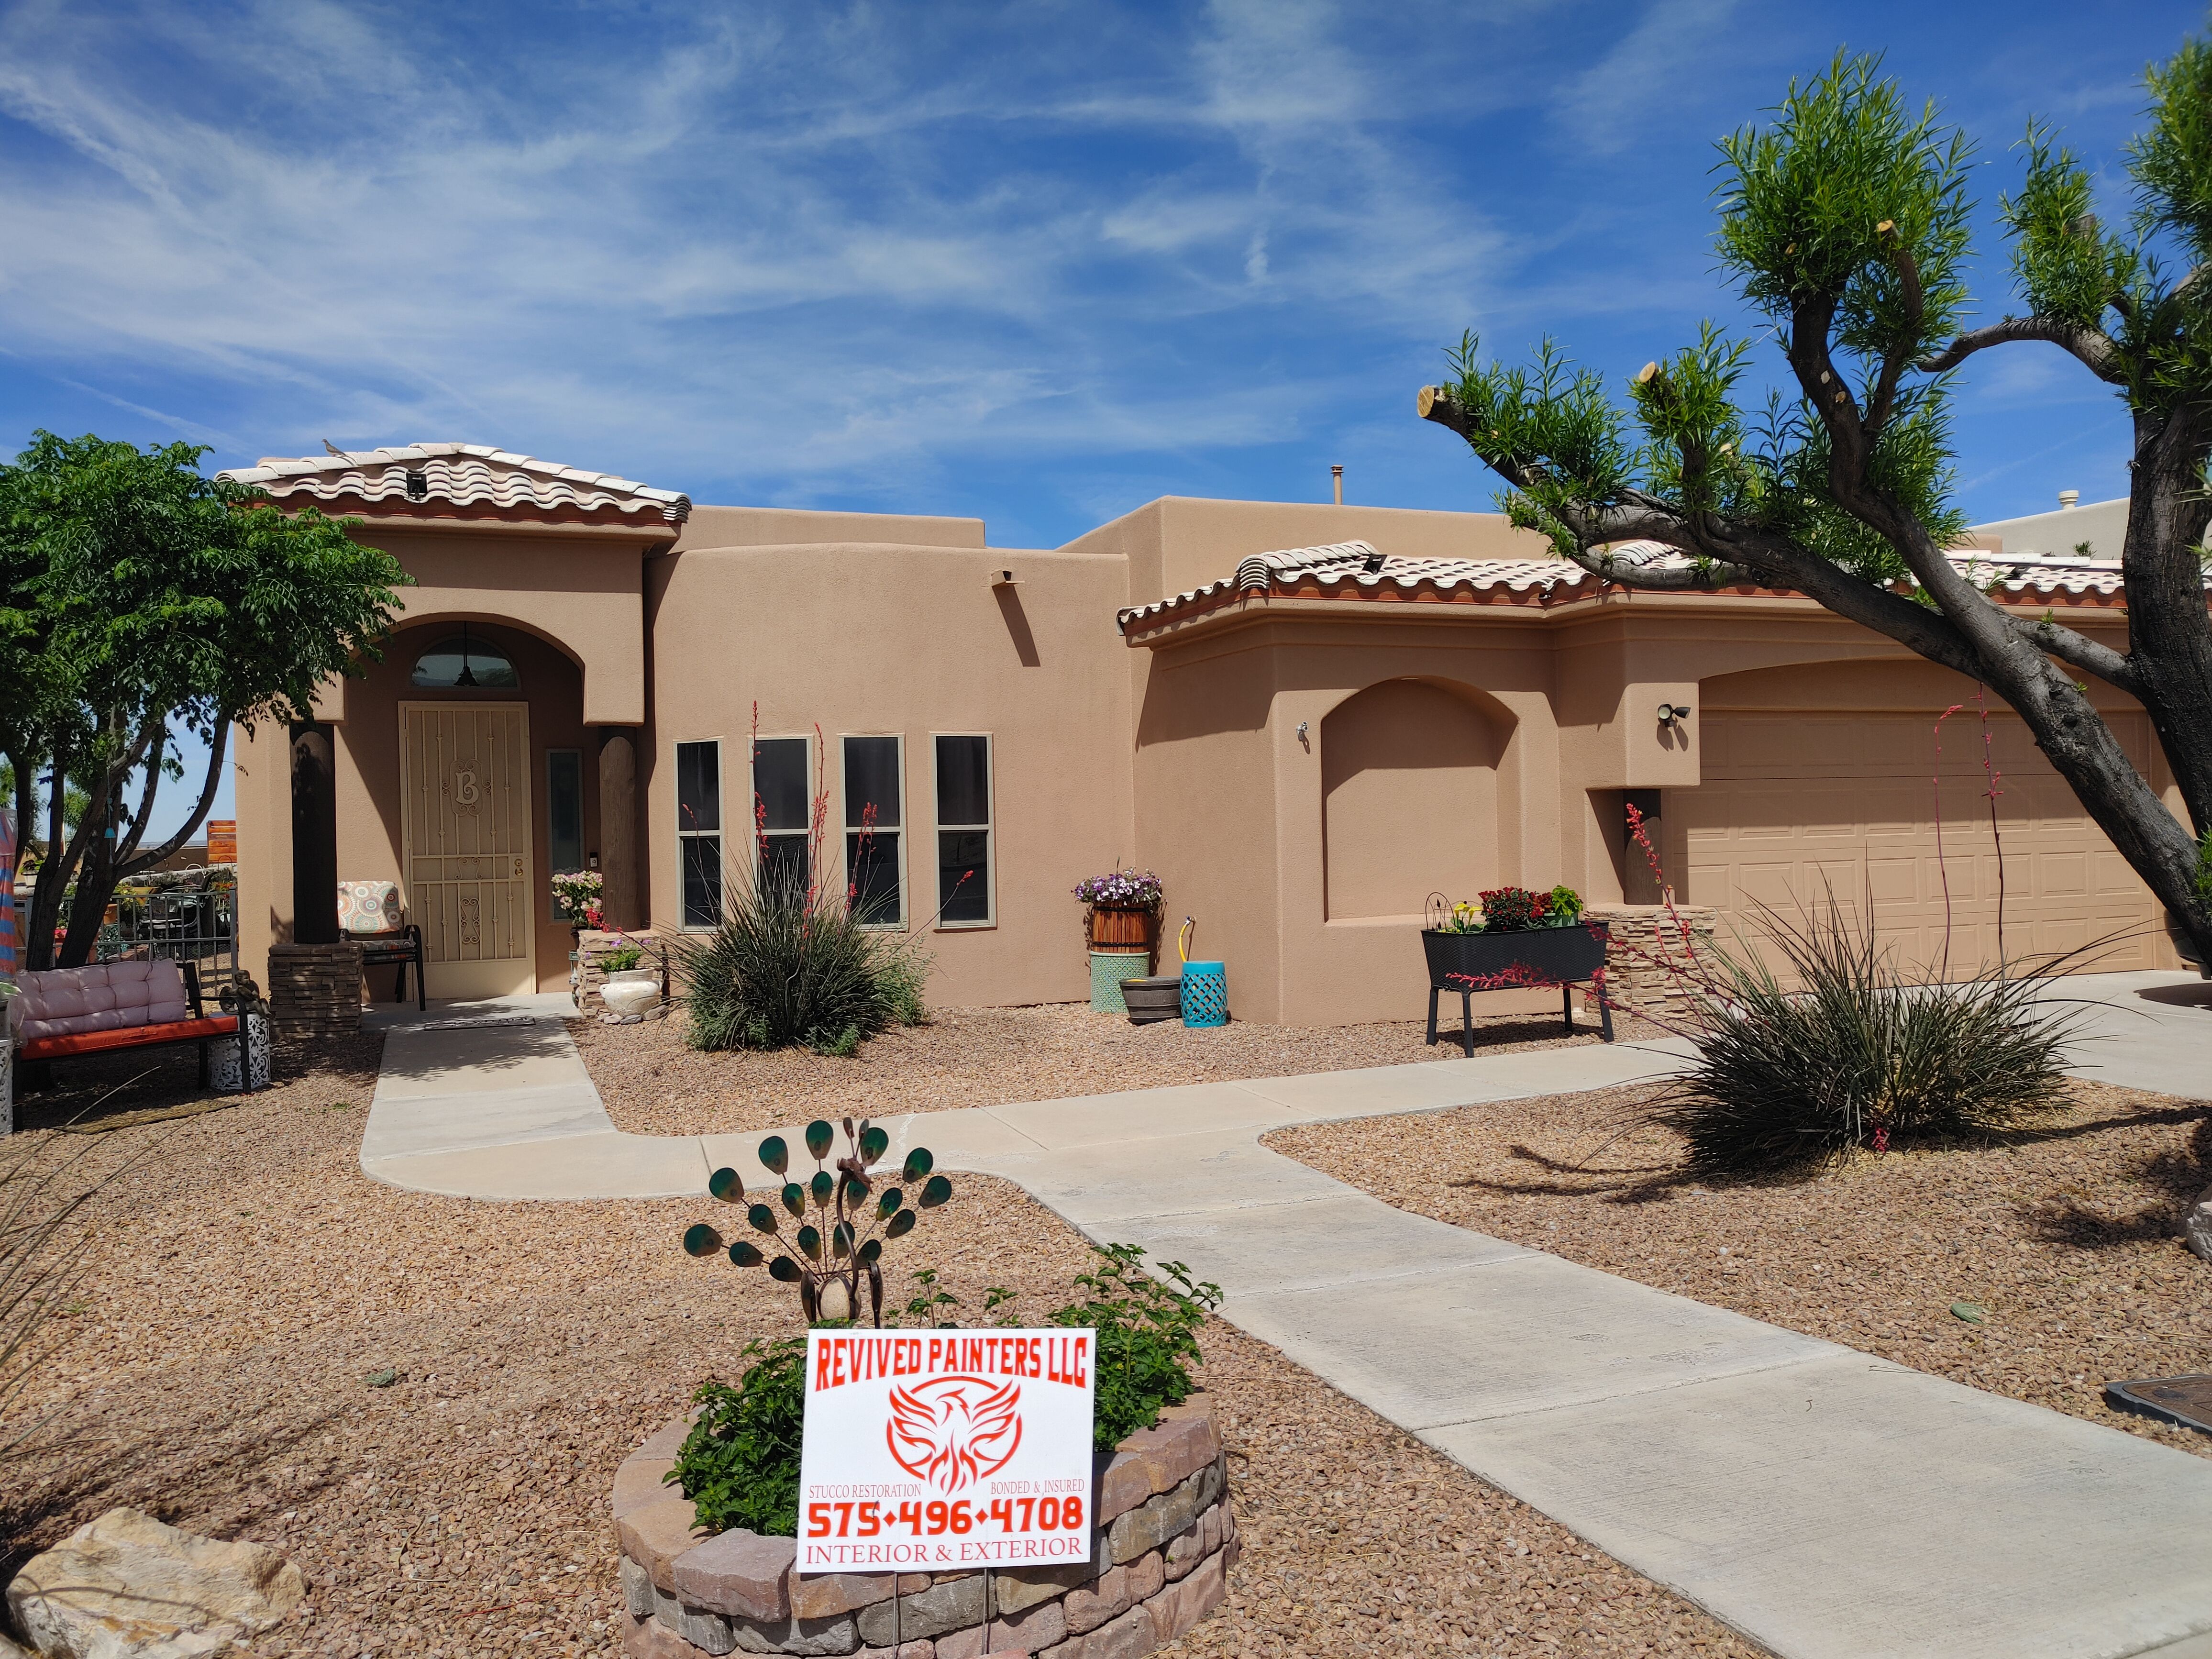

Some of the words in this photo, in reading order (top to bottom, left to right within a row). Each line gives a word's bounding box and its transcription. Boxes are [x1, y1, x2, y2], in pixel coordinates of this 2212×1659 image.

[815, 1338, 921, 1392] REVIVED
[928, 1338, 1041, 1378] PAINTERS
[1047, 1337, 1088, 1389] LLC
[809, 1485, 850, 1498] STUCCO
[852, 1483, 921, 1498] RESTORATION
[991, 1481, 1030, 1494] BONDED
[1034, 1481, 1040, 1493] &
[1045, 1479, 1084, 1493] INSURED
[806, 1544, 929, 1564] INTERIOR
[936, 1544, 952, 1561] &
[960, 1537, 1083, 1561] EXTERIOR
